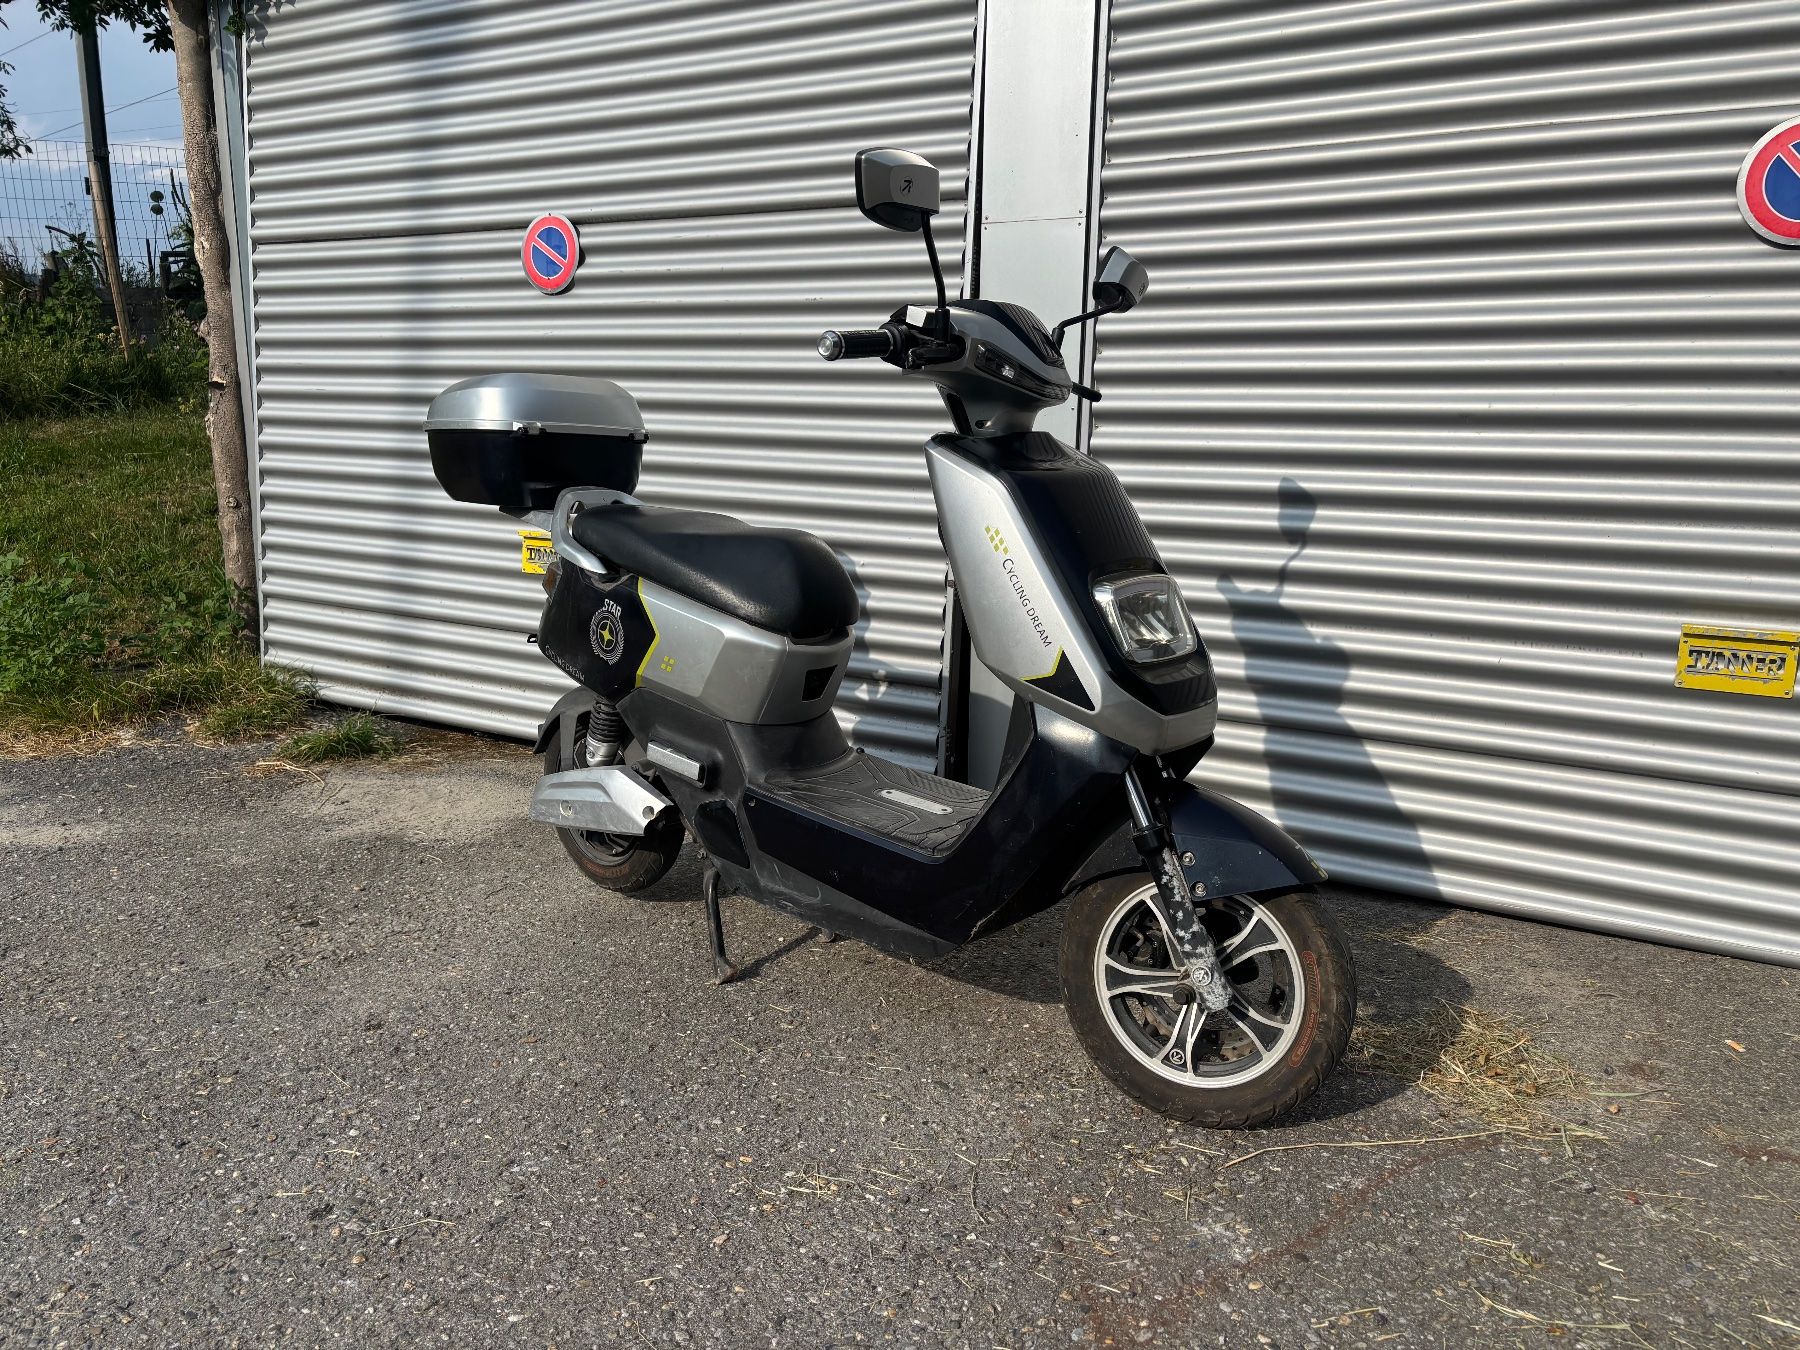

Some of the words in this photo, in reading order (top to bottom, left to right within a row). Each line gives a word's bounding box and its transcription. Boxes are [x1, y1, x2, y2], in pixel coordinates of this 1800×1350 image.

[603, 598, 622, 620] STAR
[1002, 558, 1031, 607] CYCLING
[1026, 607, 1052, 648] DREAM
[1686, 648, 1787, 677] TANNER
